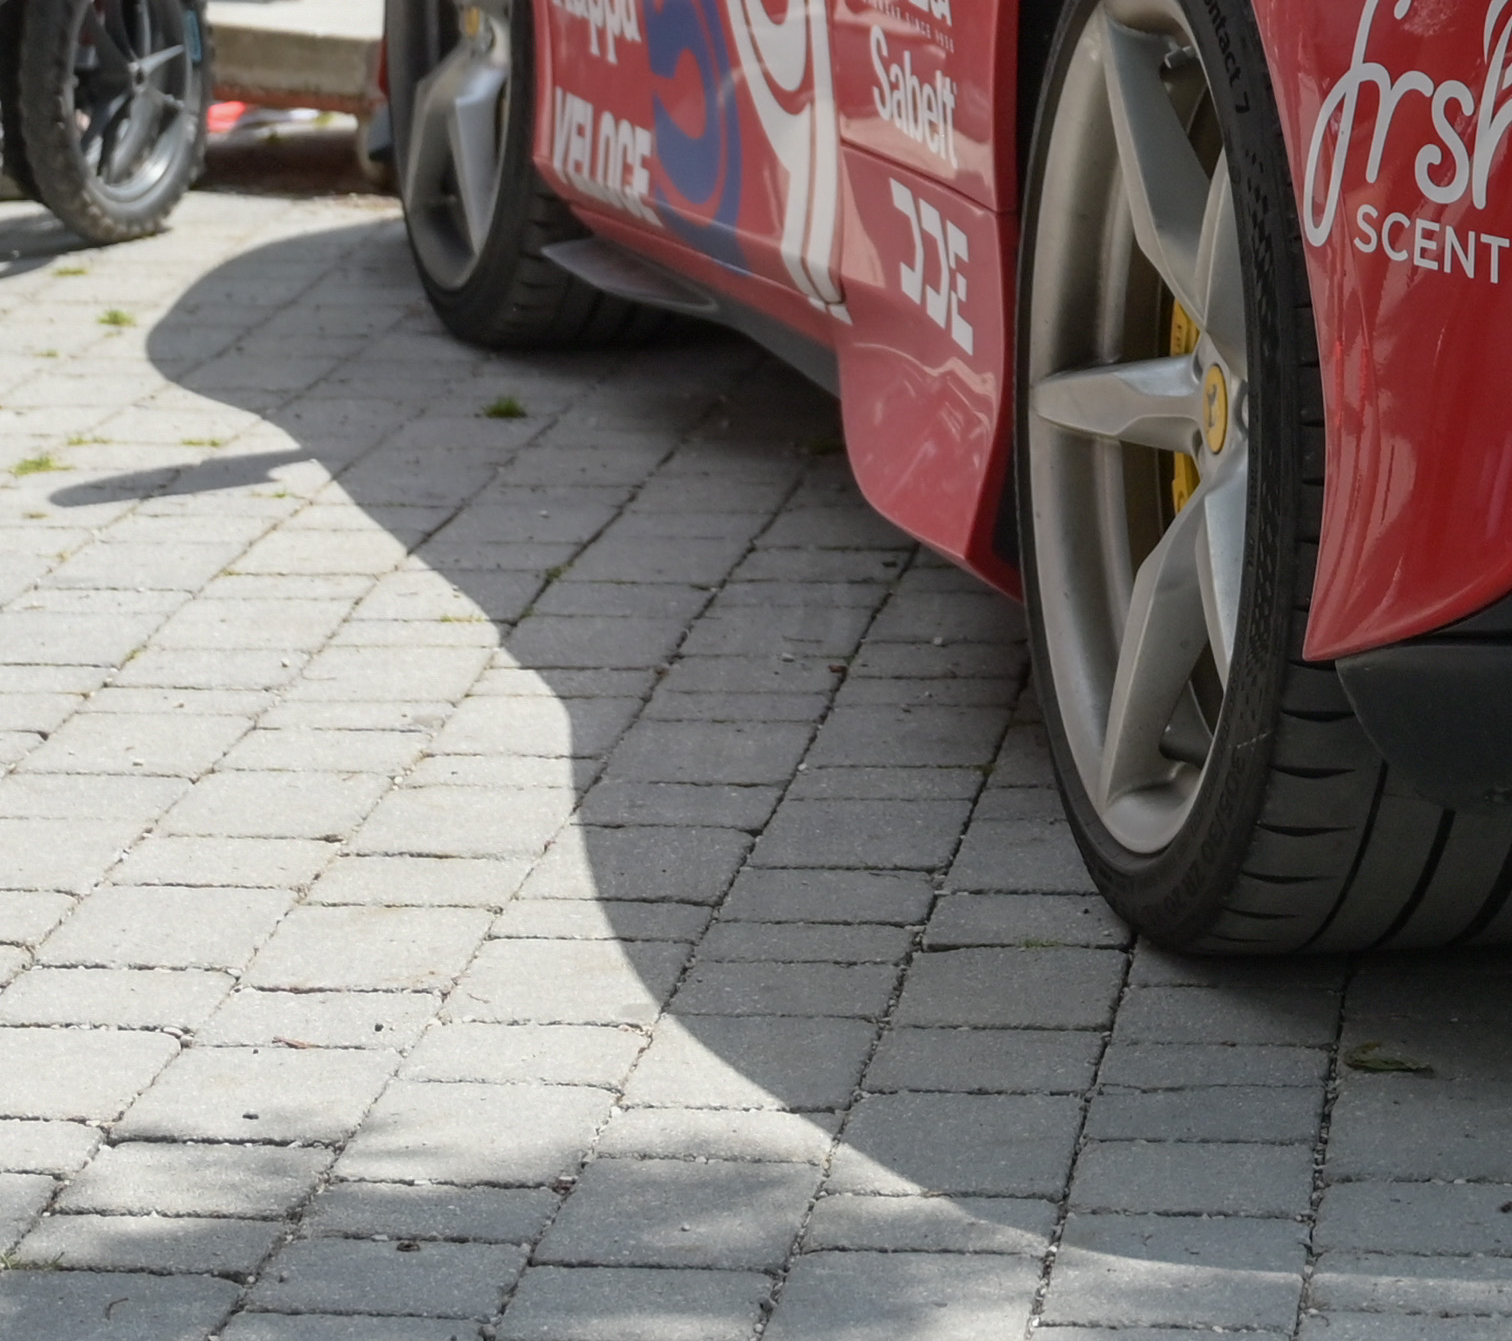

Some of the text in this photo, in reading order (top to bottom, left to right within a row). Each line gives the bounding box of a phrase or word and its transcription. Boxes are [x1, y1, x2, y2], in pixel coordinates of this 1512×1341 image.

[552, 85, 664, 228] VELOCE
[870, 23, 958, 169] Sabelt
[1235, 91, 1251, 115] 7
